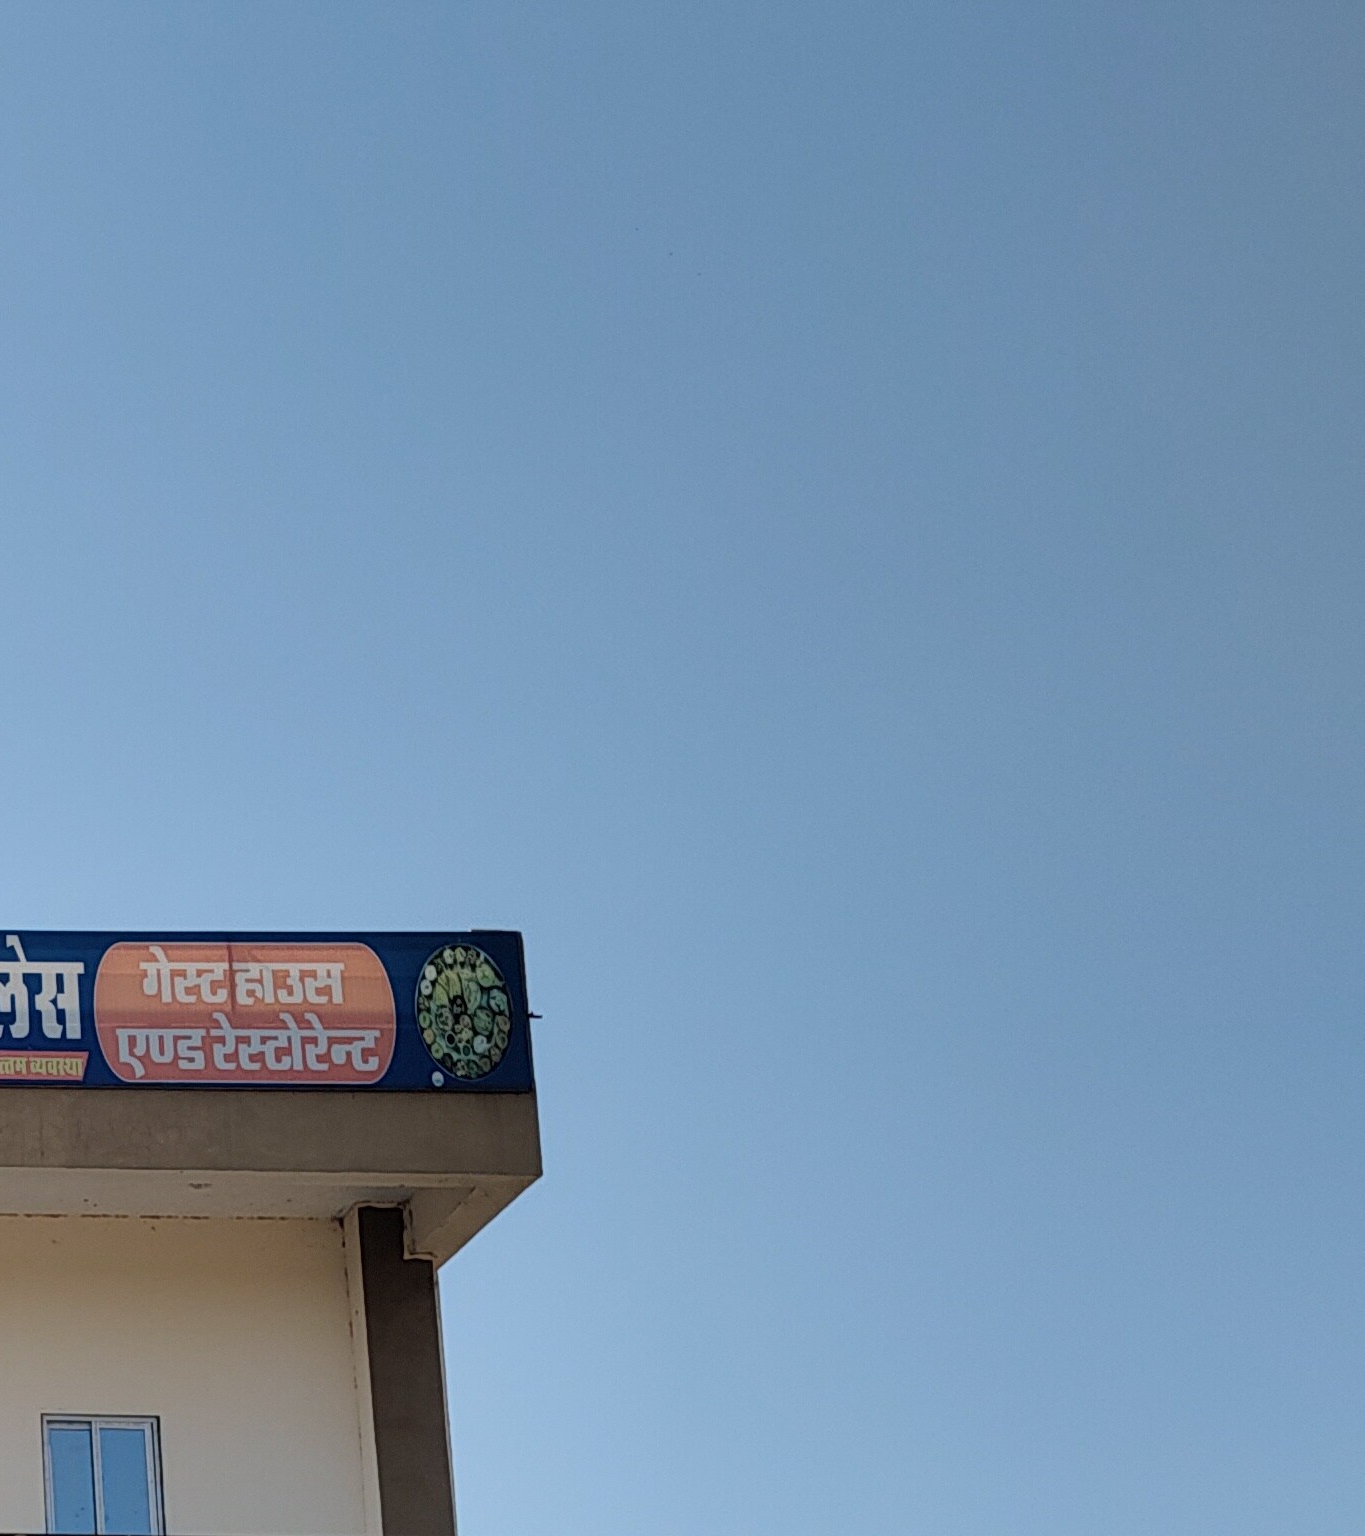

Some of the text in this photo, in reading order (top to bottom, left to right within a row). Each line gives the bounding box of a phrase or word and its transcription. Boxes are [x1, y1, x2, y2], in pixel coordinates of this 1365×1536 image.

[140, 946, 345, 1006] गेस्ट हाउस
[116, 1013, 381, 1078] एण्ड रेस्टोरेन्ट
